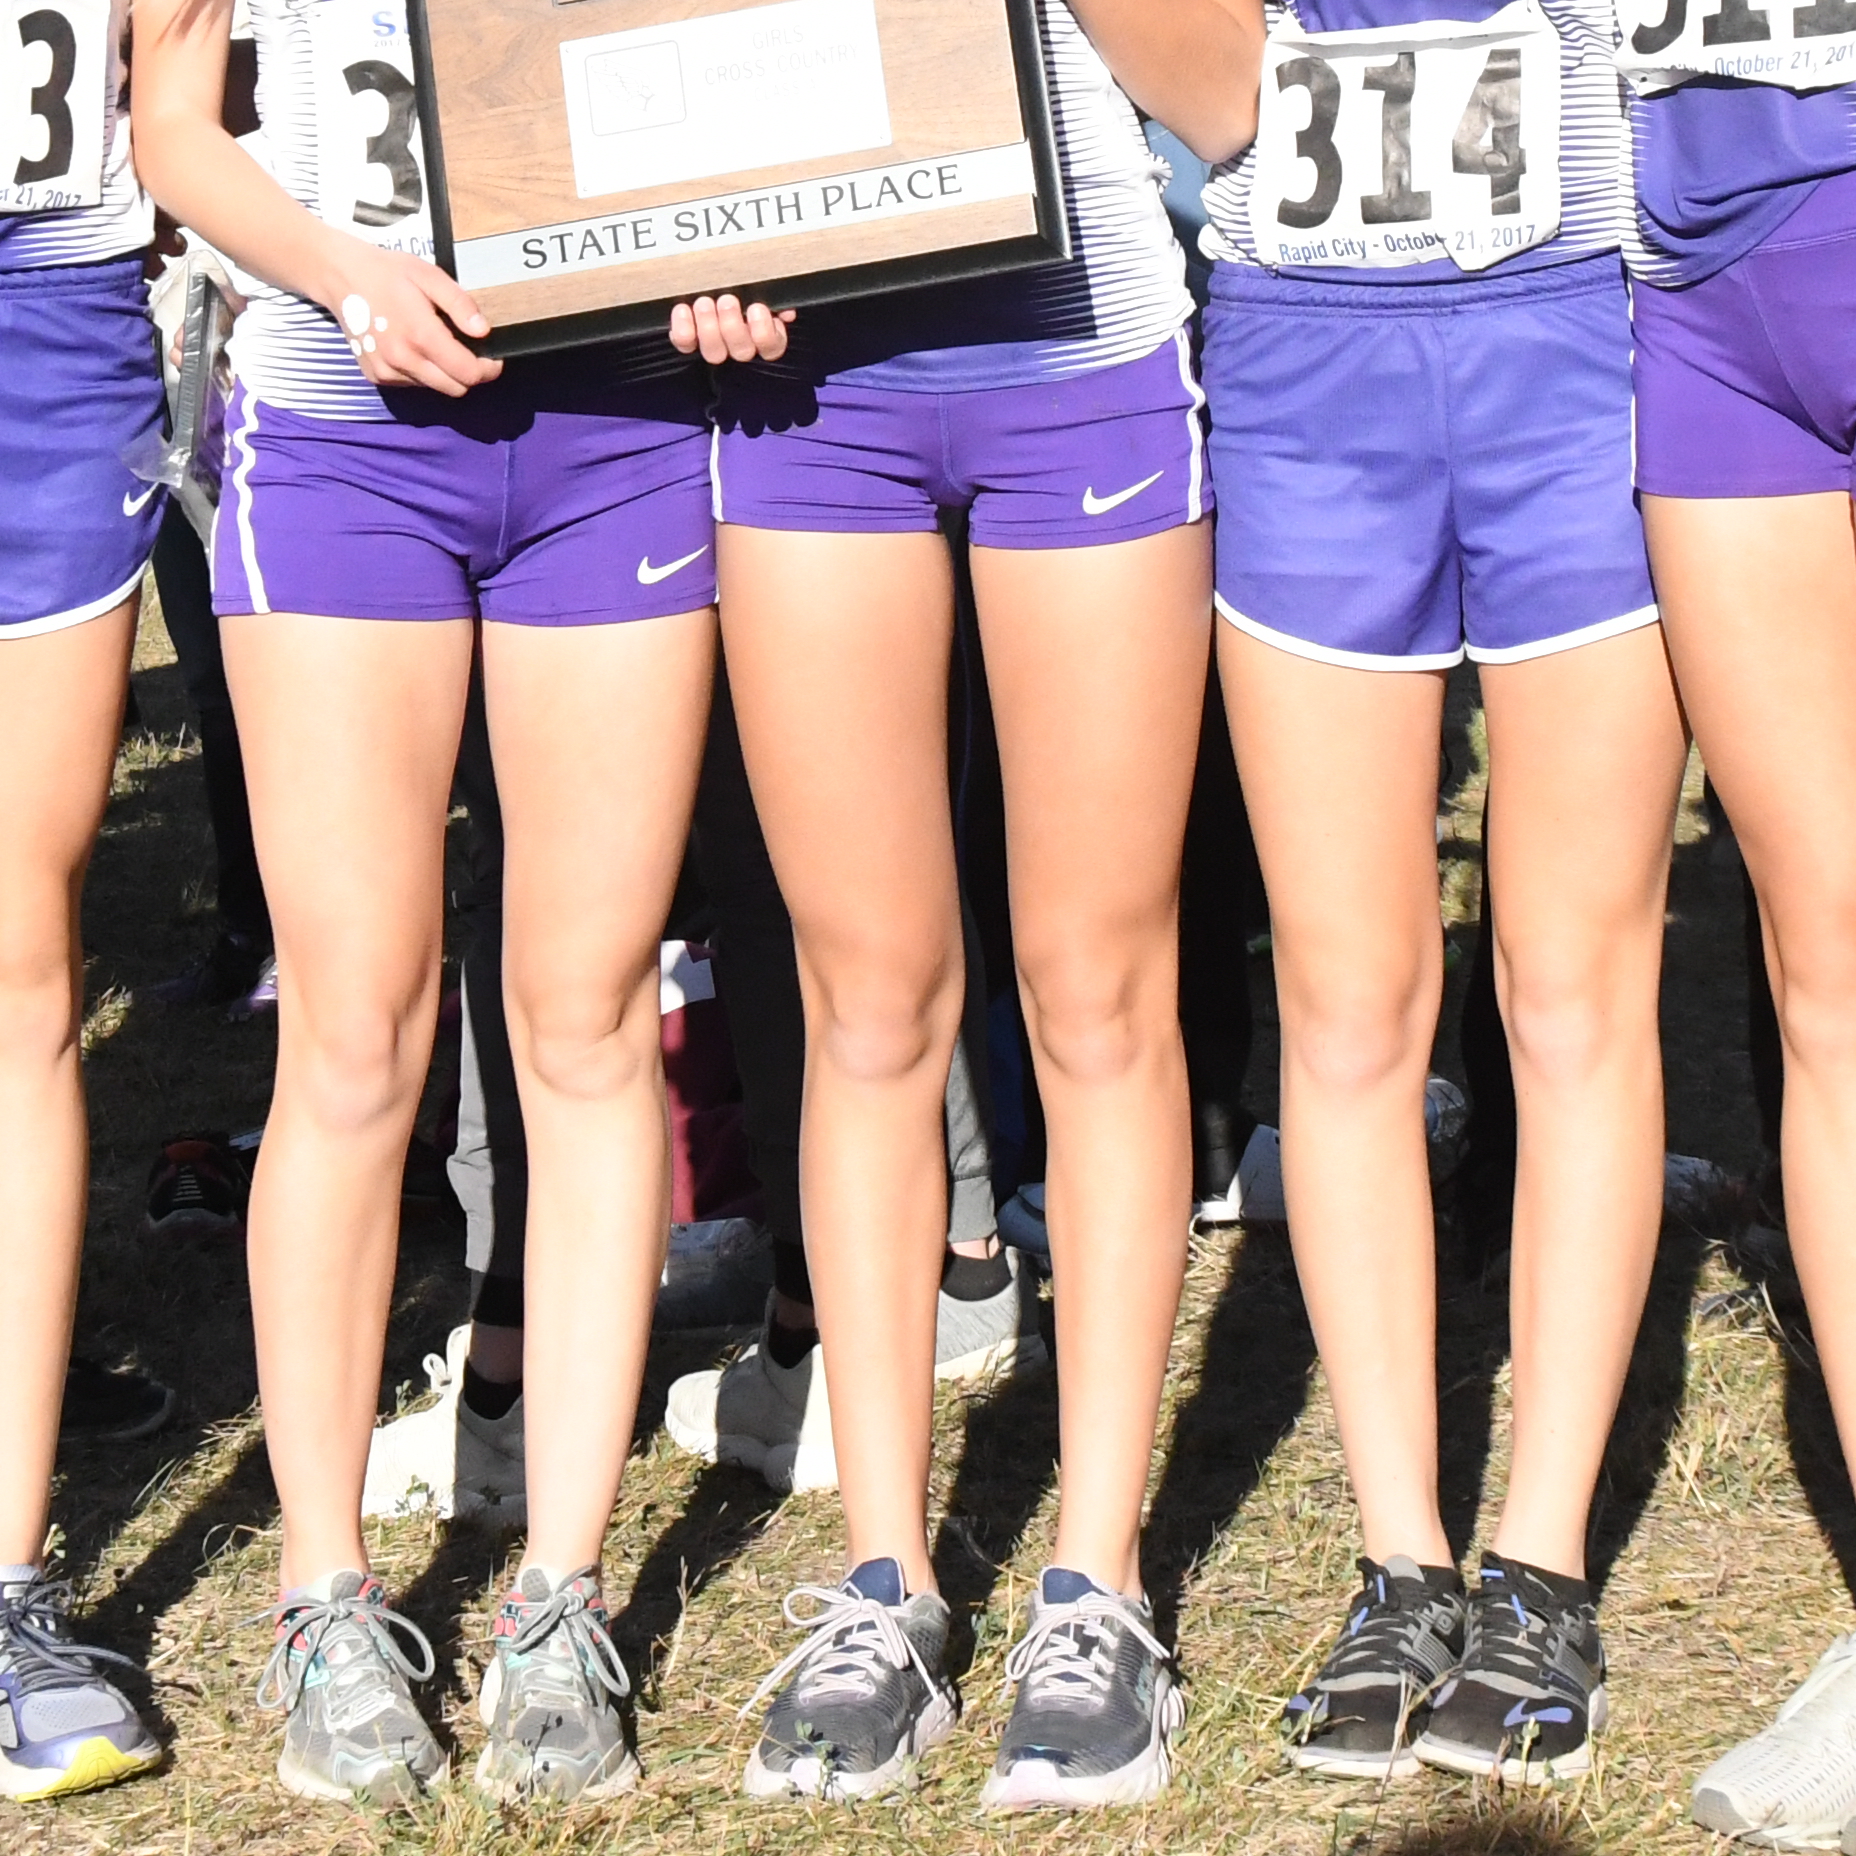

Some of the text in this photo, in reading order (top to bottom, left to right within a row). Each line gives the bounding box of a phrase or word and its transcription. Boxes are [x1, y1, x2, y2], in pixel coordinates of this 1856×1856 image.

[752, 24, 805, 50] GIRLS
[704, 42, 859, 86] CROSS COUNTRY
[1714, 53, 1784, 77] October
[1275, 48, 1528, 230] 314
[522, 163, 964, 270] STATE SIXTH PLACE
[409, 236, 435, 257] Cit
[1277, 241, 1329, 263] Rapid
[1333, 238, 1367, 259] City
[1383, 233, 1446, 253] Octob
[1454, 230, 1484, 254] 21,
[1490, 224, 1536, 249] 2017
